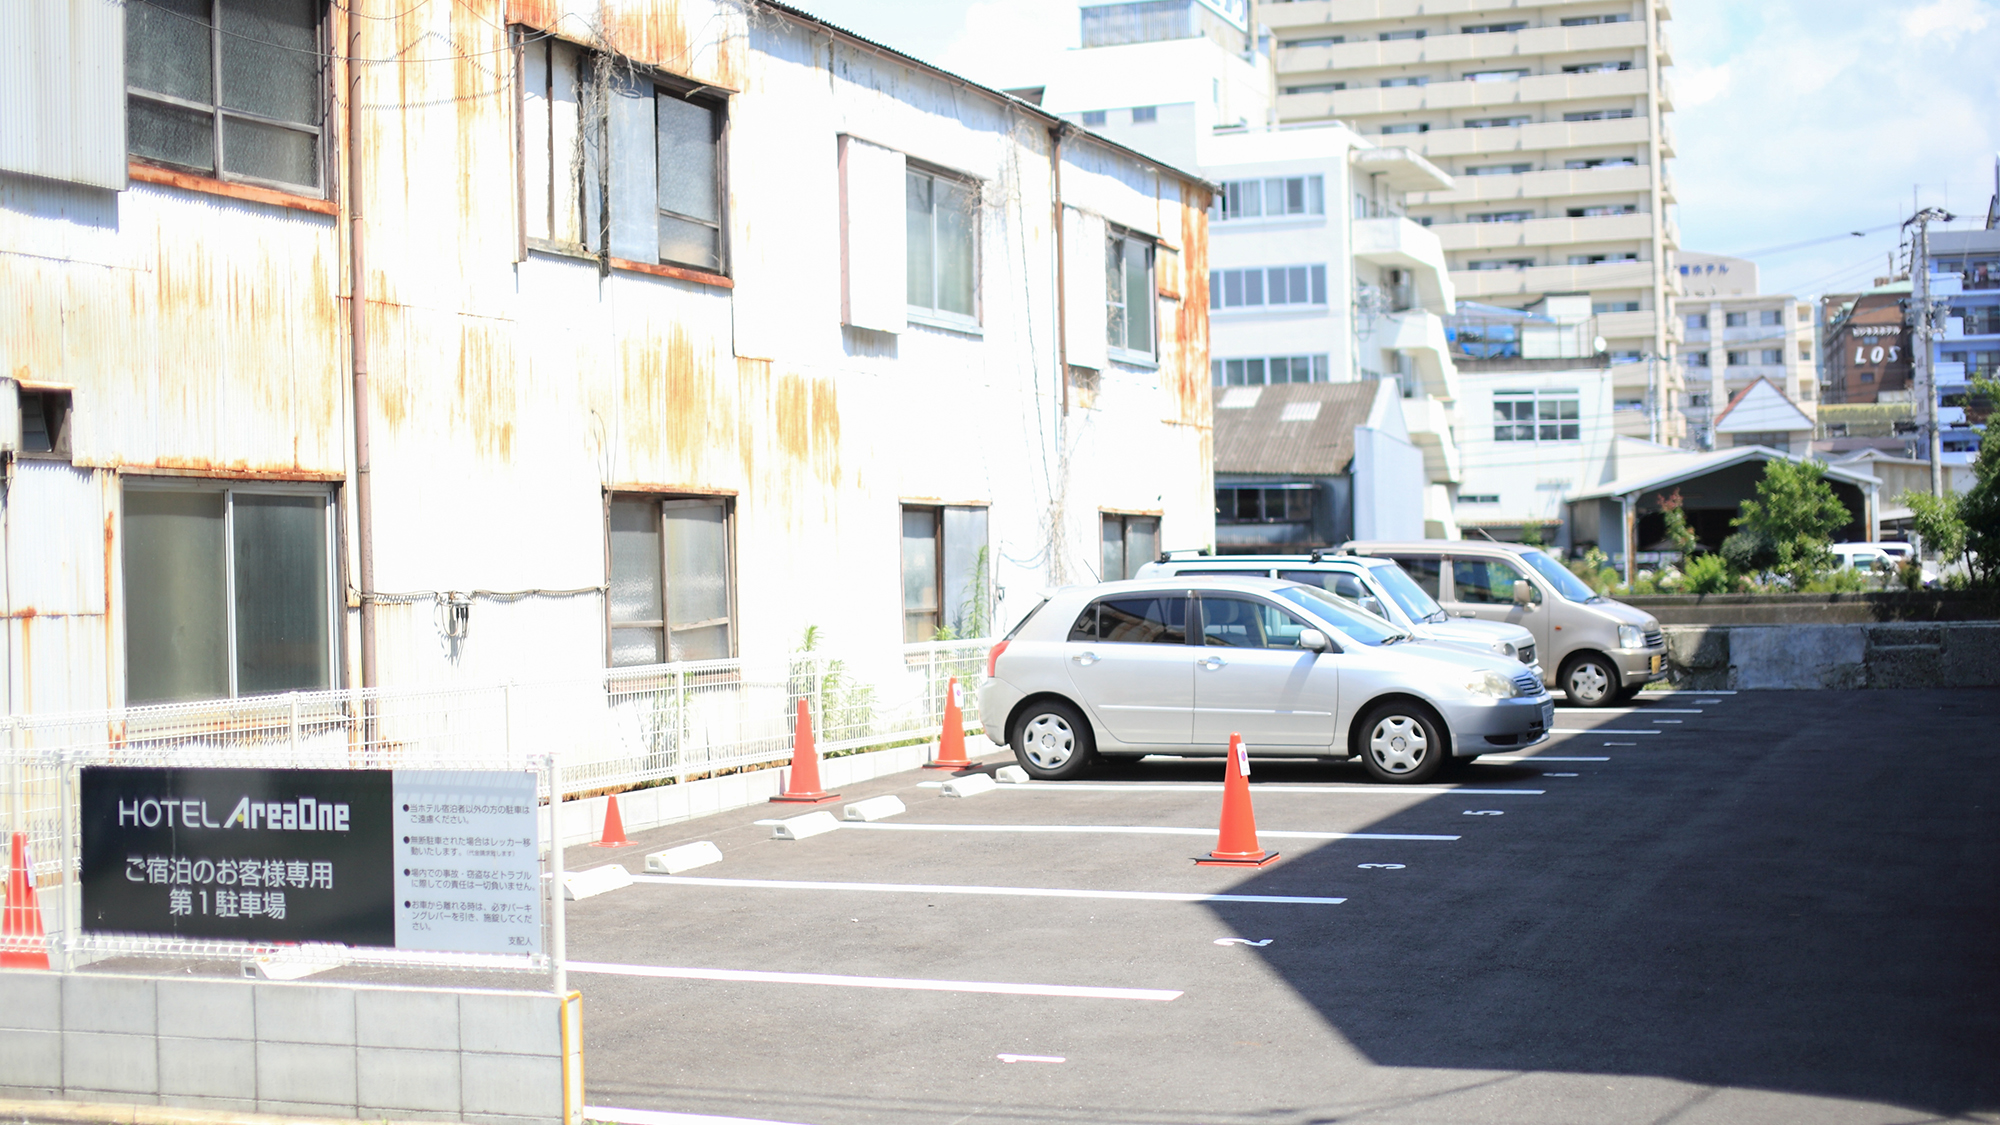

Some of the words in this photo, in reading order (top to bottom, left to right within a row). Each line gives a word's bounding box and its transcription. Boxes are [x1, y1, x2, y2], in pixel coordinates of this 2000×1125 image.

[1855, 346, 1901, 364] LOS
[118, 799, 220, 828] HOTEL
[223, 797, 350, 831] AreaOne
[410, 804, 530, 814] 当ホテル宿泊者以外の方の駐車は
[410, 815, 470, 824] ご遠慮ください。
[410, 836, 531, 847] 無断駐車された場合はレッカー移
[410, 847, 462, 856] 動いたします。
[125, 857, 334, 889] ご宿泊のお客様専用
[411, 880, 536, 891] に際しての責任は一切負いません。
[412, 922, 432, 931] さい。
[508, 936, 533, 946] 支配人
[1213, 937, 1274, 947] 2
[996, 1053, 1066, 1063] 1
